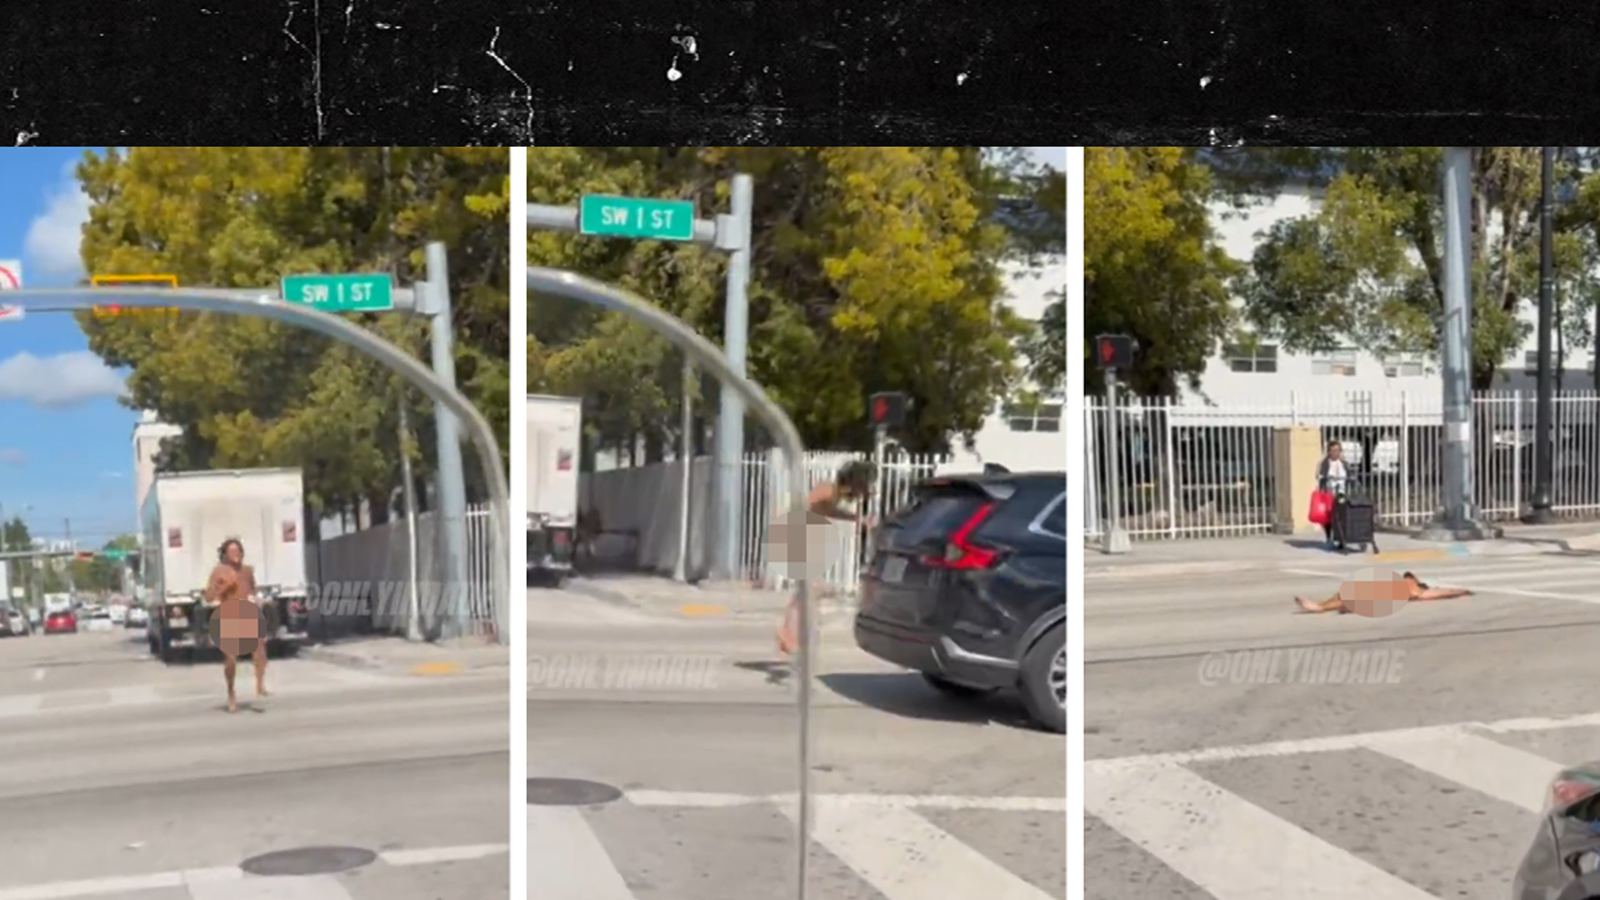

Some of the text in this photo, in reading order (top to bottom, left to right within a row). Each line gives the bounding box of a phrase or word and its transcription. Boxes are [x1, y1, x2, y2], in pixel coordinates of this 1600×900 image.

[601, 205, 628, 226] SW
[651, 209, 675, 230] ST
[302, 284, 329, 303] SW
[351, 282, 374, 302] ST
